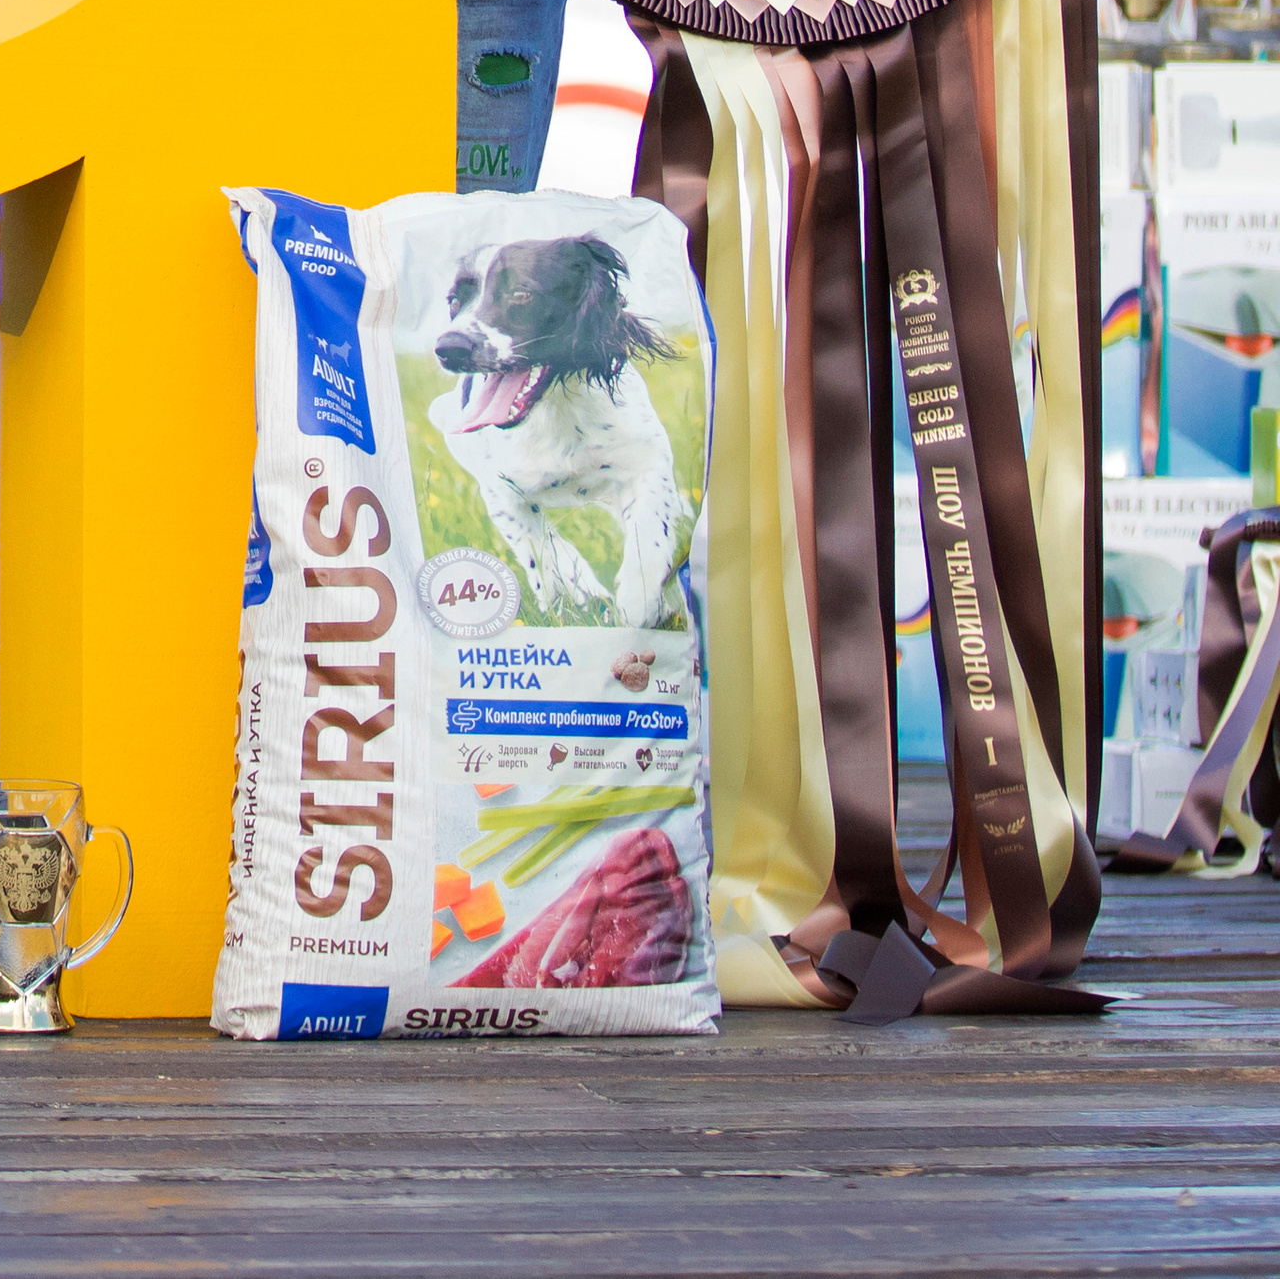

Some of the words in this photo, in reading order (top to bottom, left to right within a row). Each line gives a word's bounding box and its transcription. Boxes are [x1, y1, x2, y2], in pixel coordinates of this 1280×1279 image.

[457, 144, 509, 177] LOVE
[285, 238, 357, 267] PREMIUM
[301, 261, 337, 277] FOOD
[312, 354, 357, 401] ADULT
[908, 385, 959, 407] SIRIUS
[917, 406, 955, 425] GOLD
[912, 423, 967, 446] WINNER
[932, 466, 967, 530] ШОУ
[435, 548, 503, 572] СОДЕРЖАНИЕ
[437, 578, 501, 607] 44%
[498, 569, 517, 622] ЖИВОТНЫХ
[429, 611, 503, 637] ИНГРЕДИЕНТОВ
[945, 540, 997, 712] ЧЕМПИОНОВ
[458, 644, 573, 668] ИНДЕЙКА
[460, 671, 476, 689] И
[482, 671, 542, 690] УТКА
[656, 679, 668, 693] 12
[669, 684, 681, 695] кг
[249, 682, 262, 742] УТКА
[294, 485, 398, 922] SIRIUS
[485, 707, 547, 726] Комплекс
[548, 710, 622, 728] пробиотиков
[625, 709, 684, 730] ProStor+
[250, 748, 262, 763] И
[498, 744, 539, 758] Здоровая
[574, 746, 606, 758] Высокая
[498, 758, 528, 770] шерсть
[573, 759, 628, 771] питательность
[242, 769, 259, 878] ИНДЕЙКА
[289, 936, 390, 957] PREMIUM
[298, 1014, 367, 1035] ADULT
